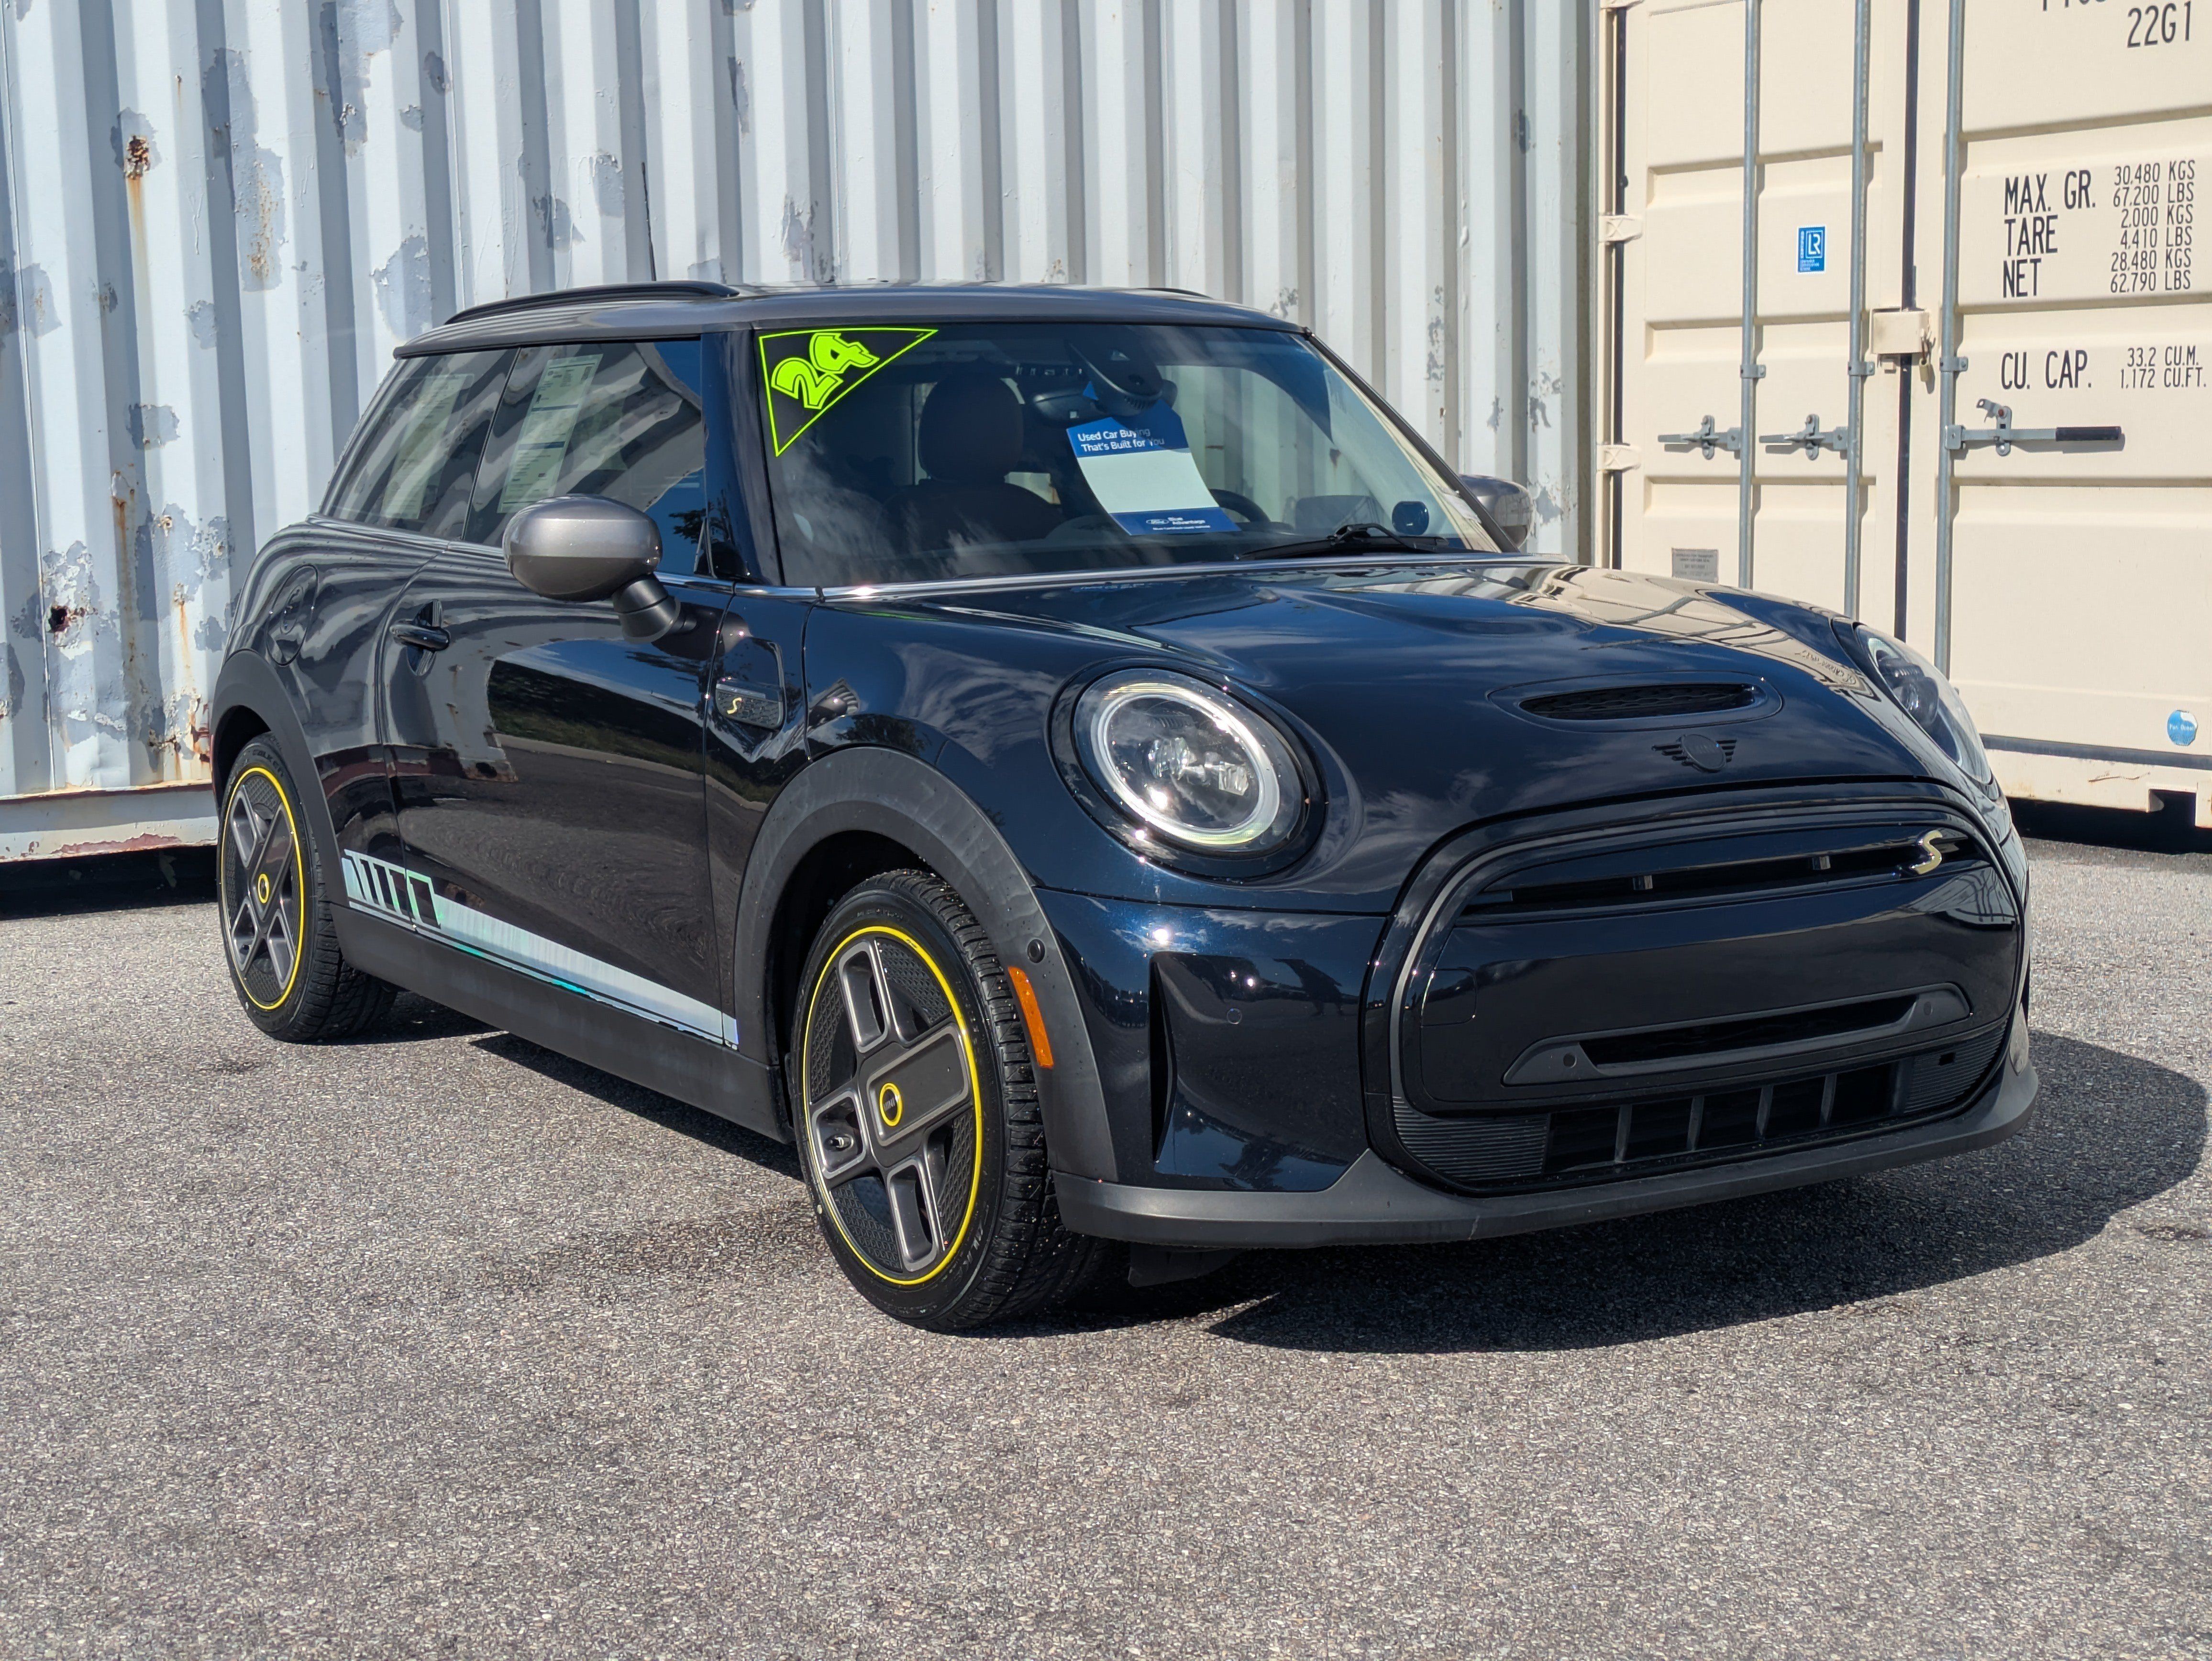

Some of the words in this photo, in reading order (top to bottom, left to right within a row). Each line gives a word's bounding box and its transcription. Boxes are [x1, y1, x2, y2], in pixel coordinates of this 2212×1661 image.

[2127, 0, 2191, 48] 22G1
[2168, 160, 2195, 181] KGS
[2004, 173, 2051, 215] MAX.
[2064, 170, 2096, 210] GR.
[2168, 181, 2194, 203] LBS
[2167, 204, 2193, 225] KGS
[1808, 233, 1821, 255] LR
[2004, 214, 2058, 256] TARE
[2166, 226, 2192, 247] LBS
[2166, 247, 2191, 269] KGS
[2003, 258, 2042, 298] NET
[2165, 270, 2190, 290] LBS
[2127, 347, 2156, 367] 33.2
[771, 332, 879, 410] 24
[2001, 352, 2030, 389] CU.
[2046, 350, 2091, 388] CAP.
[1078, 432, 1102, 441] Used
[1119, 429, 1150, 438] Buying
[1081, 442, 1109, 452] That's
[1110, 440, 1132, 450] Built
[1133, 439, 1146, 447] for
[1149, 437, 1165, 446] You
[726, 697, 742, 715] S
[1913, 830, 1943, 875] S
